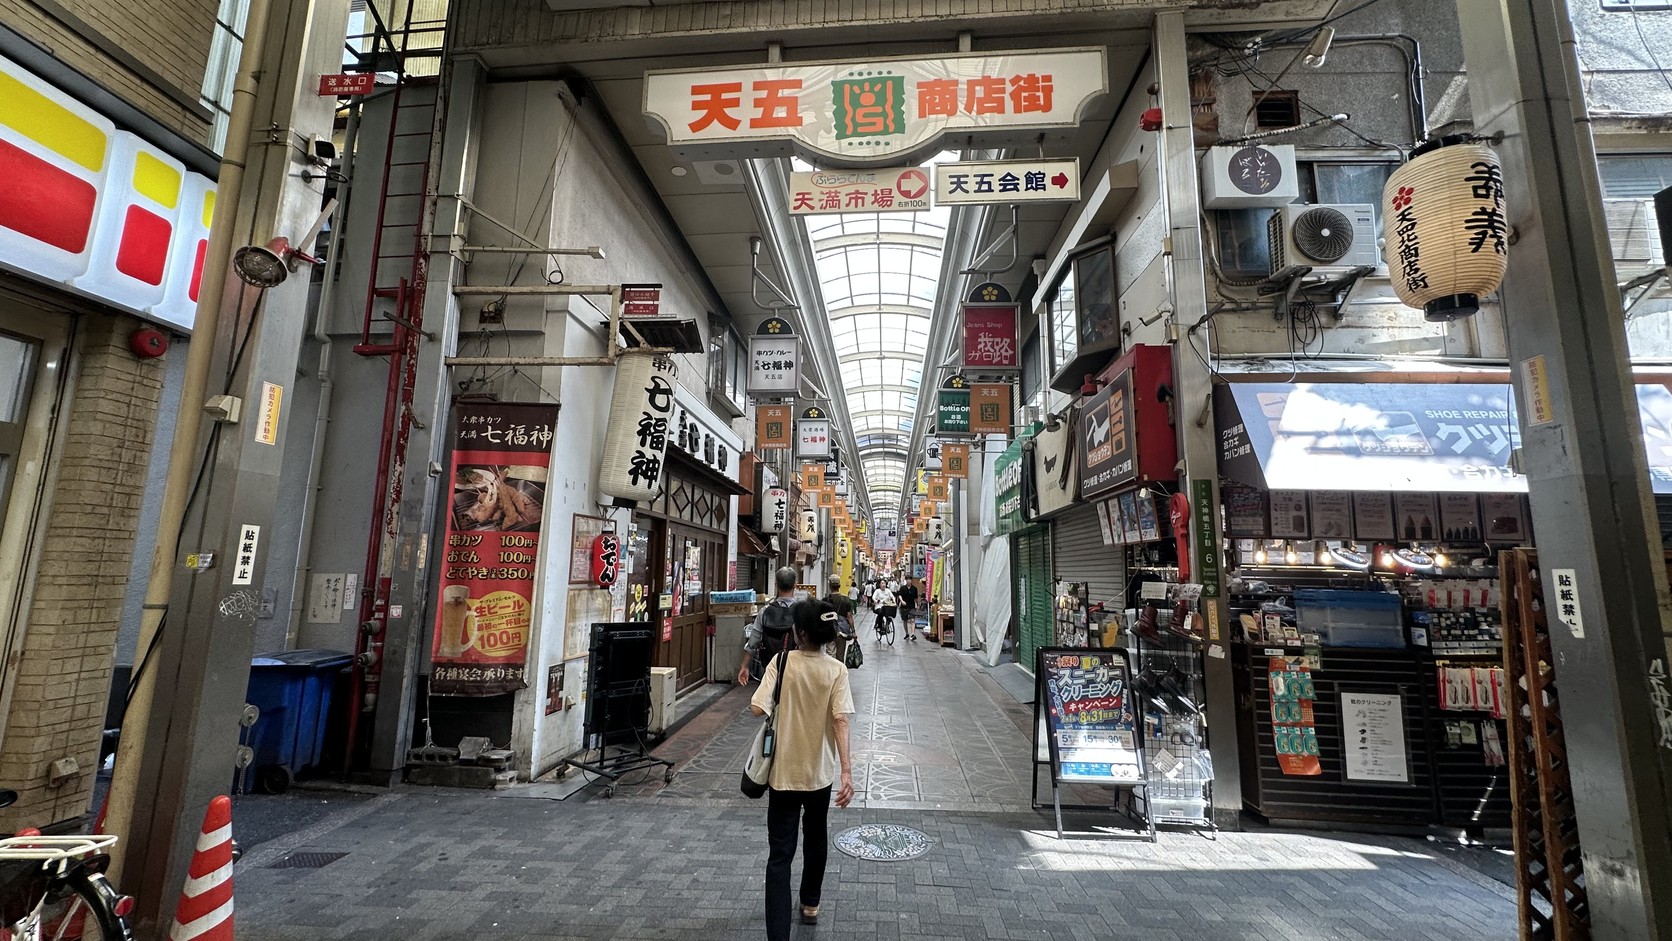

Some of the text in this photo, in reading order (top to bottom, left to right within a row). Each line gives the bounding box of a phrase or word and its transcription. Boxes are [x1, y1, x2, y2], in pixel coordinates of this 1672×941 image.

[328, 77, 367, 86] 送水口
[688, 73, 1054, 133] 天五 商店街
[948, 169, 1047, 193] 天五会館
[792, 188, 895, 211] 天満市場
[1395, 205, 1430, 294] 天四北商店街
[966, 321, 1003, 329] Jeans Shop
[761, 360, 795, 371] 七福神
[981, 388, 998, 397] 天五
[767, 409, 782, 417] 天五
[1425, 410, 1461, 419] SHOE
[1462, 410, 1507, 420] REPAIR
[459, 424, 553, 449] 天満 七福神
[627, 375, 675, 490] 七福神
[802, 435, 826, 443] 七福神
[1222, 423, 1244, 440] クツ修理
[1223, 436, 1239, 450] 合カギ
[1224, 443, 1251, 460] カバン修理
[773, 498, 786, 532] 七福神
[1201, 498, 1213, 564] 天神橋五丁目 6
[449, 534, 483, 547] 串カツ
[237, 529, 256, 580] 貼紙禁止
[447, 551, 481, 564] おでん
[600, 534, 617, 584] おでん
[446, 567, 489, 580] どてやき
[475, 600, 525, 617] 生ビール
[478, 630, 522, 650] 100円
[434, 666, 525, 682] 各種宴会承ります
[1059, 667, 1121, 687] スニーカー
[1061, 680, 1122, 702] クリーニング
[1069, 698, 1117, 711] キャンペーン
